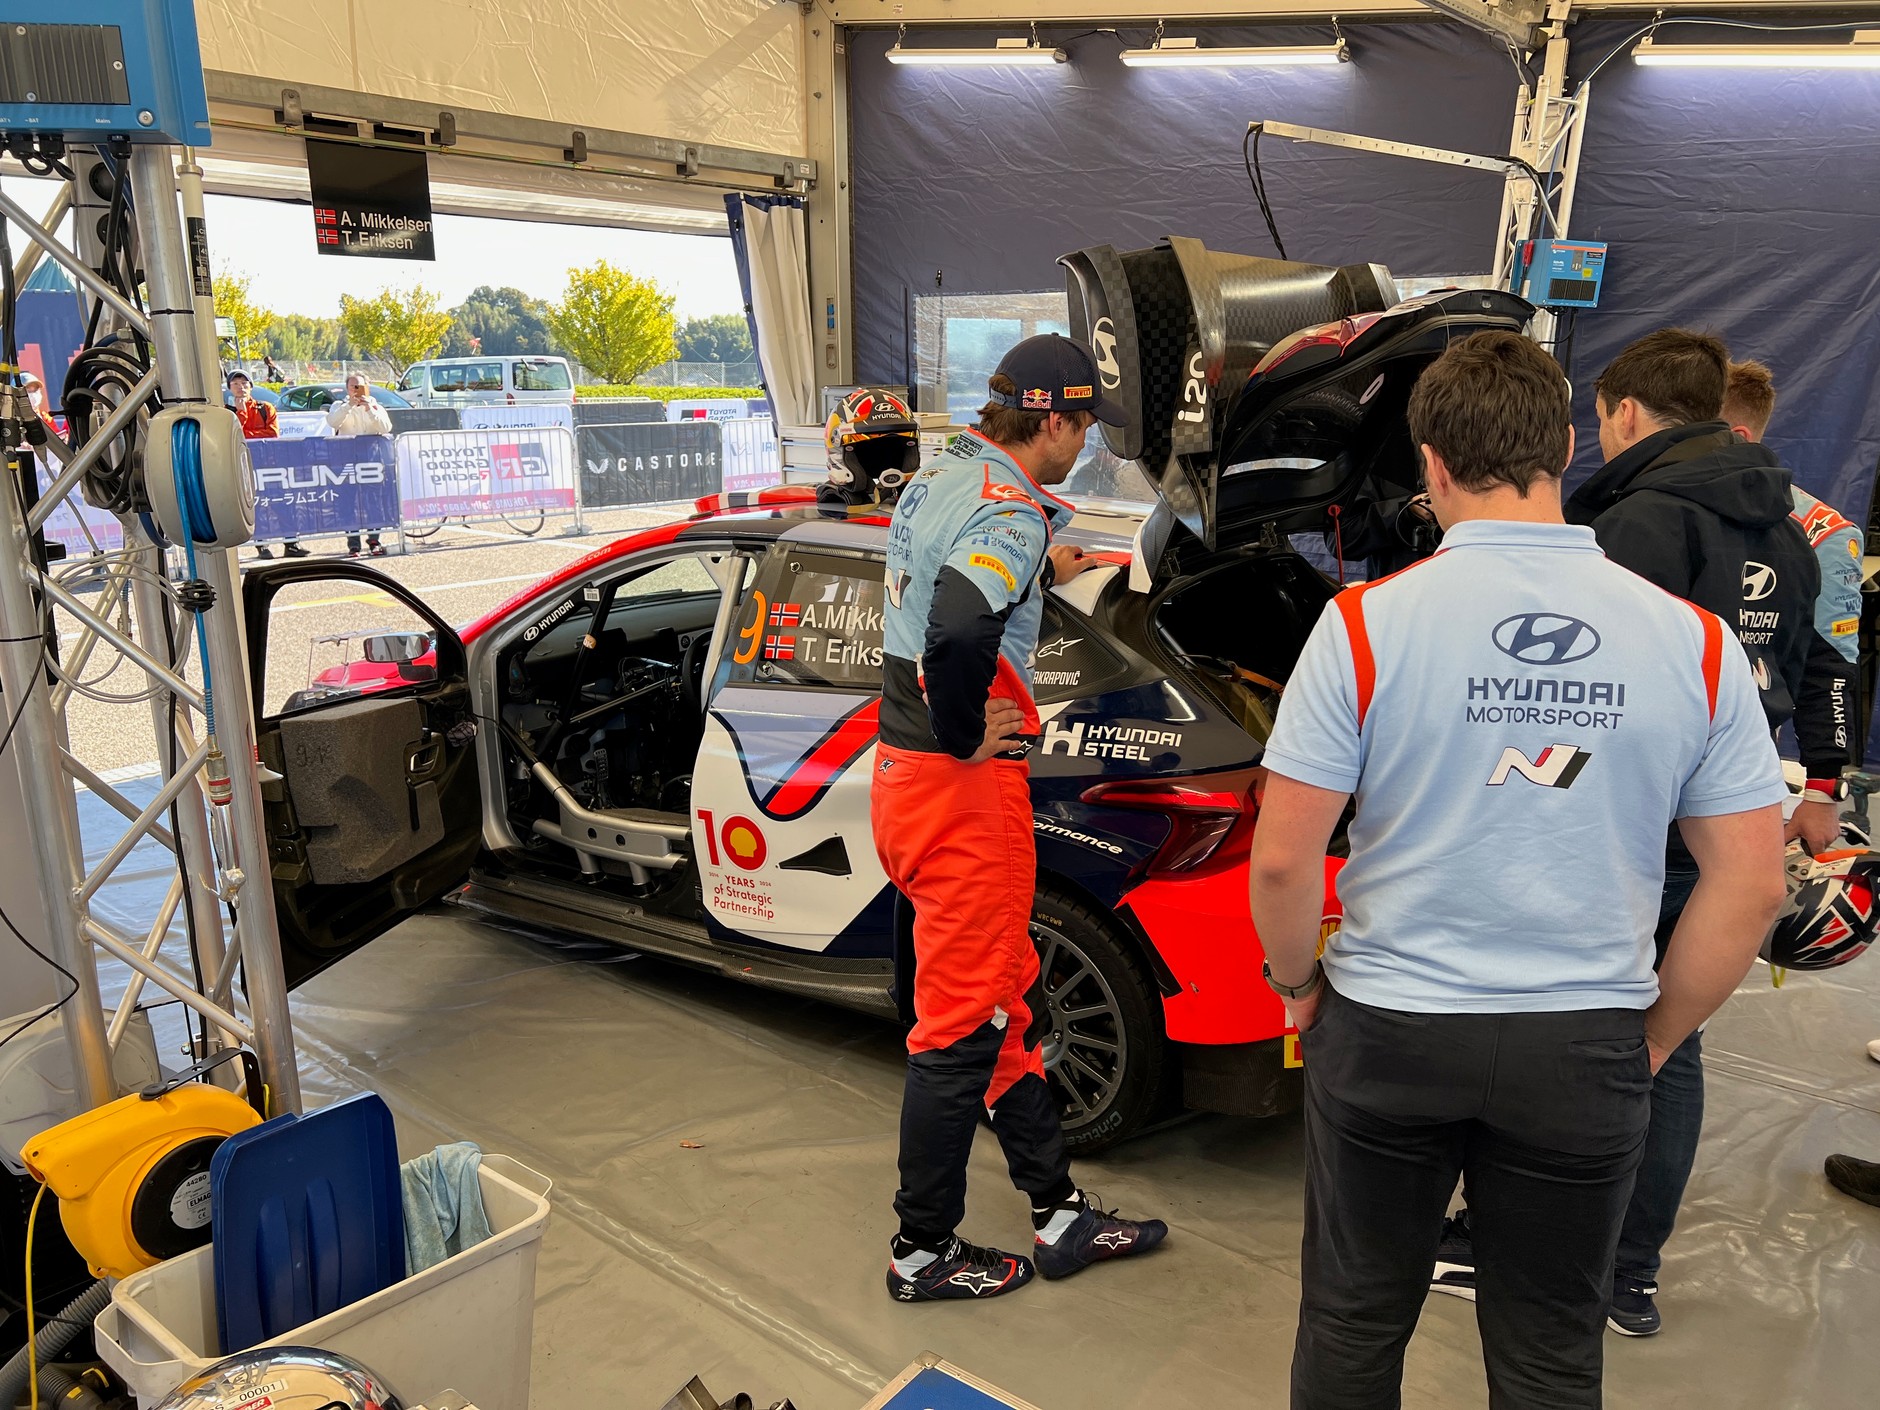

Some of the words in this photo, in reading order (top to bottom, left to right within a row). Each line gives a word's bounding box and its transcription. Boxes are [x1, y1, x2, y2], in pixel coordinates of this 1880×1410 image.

[341, 211, 356, 226] A.
[360, 212, 432, 232] Mikkelsen
[342, 230, 354, 245] T.
[359, 232, 413, 249] Eriksen
[280, 426, 304, 435] gether
[617, 452, 716, 472] CASTORE
[253, 462, 384, 491] RUM8
[538, 600, 575, 631] HYUNDAI
[802, 636, 818, 662] T.
[826, 638, 884, 667] Eriks
[1468, 677, 1625, 706] HYUNDAI
[1466, 706, 1623, 730] MOTORSPORT
[1088, 725, 1182, 747] HYUNDAI
[1084, 742, 1150, 762] STEEL
[696, 808, 768, 872] 10
[1033, 821, 1123, 854] ormance
[724, 875, 756, 888] YEARS
[714, 884, 724, 894] of
[726, 886, 772, 906] Strategic
[714, 896, 774, 920] Partnership
[1065, 1111, 1123, 1146] Cintura
[239, 1383, 276, 1402] 00001
